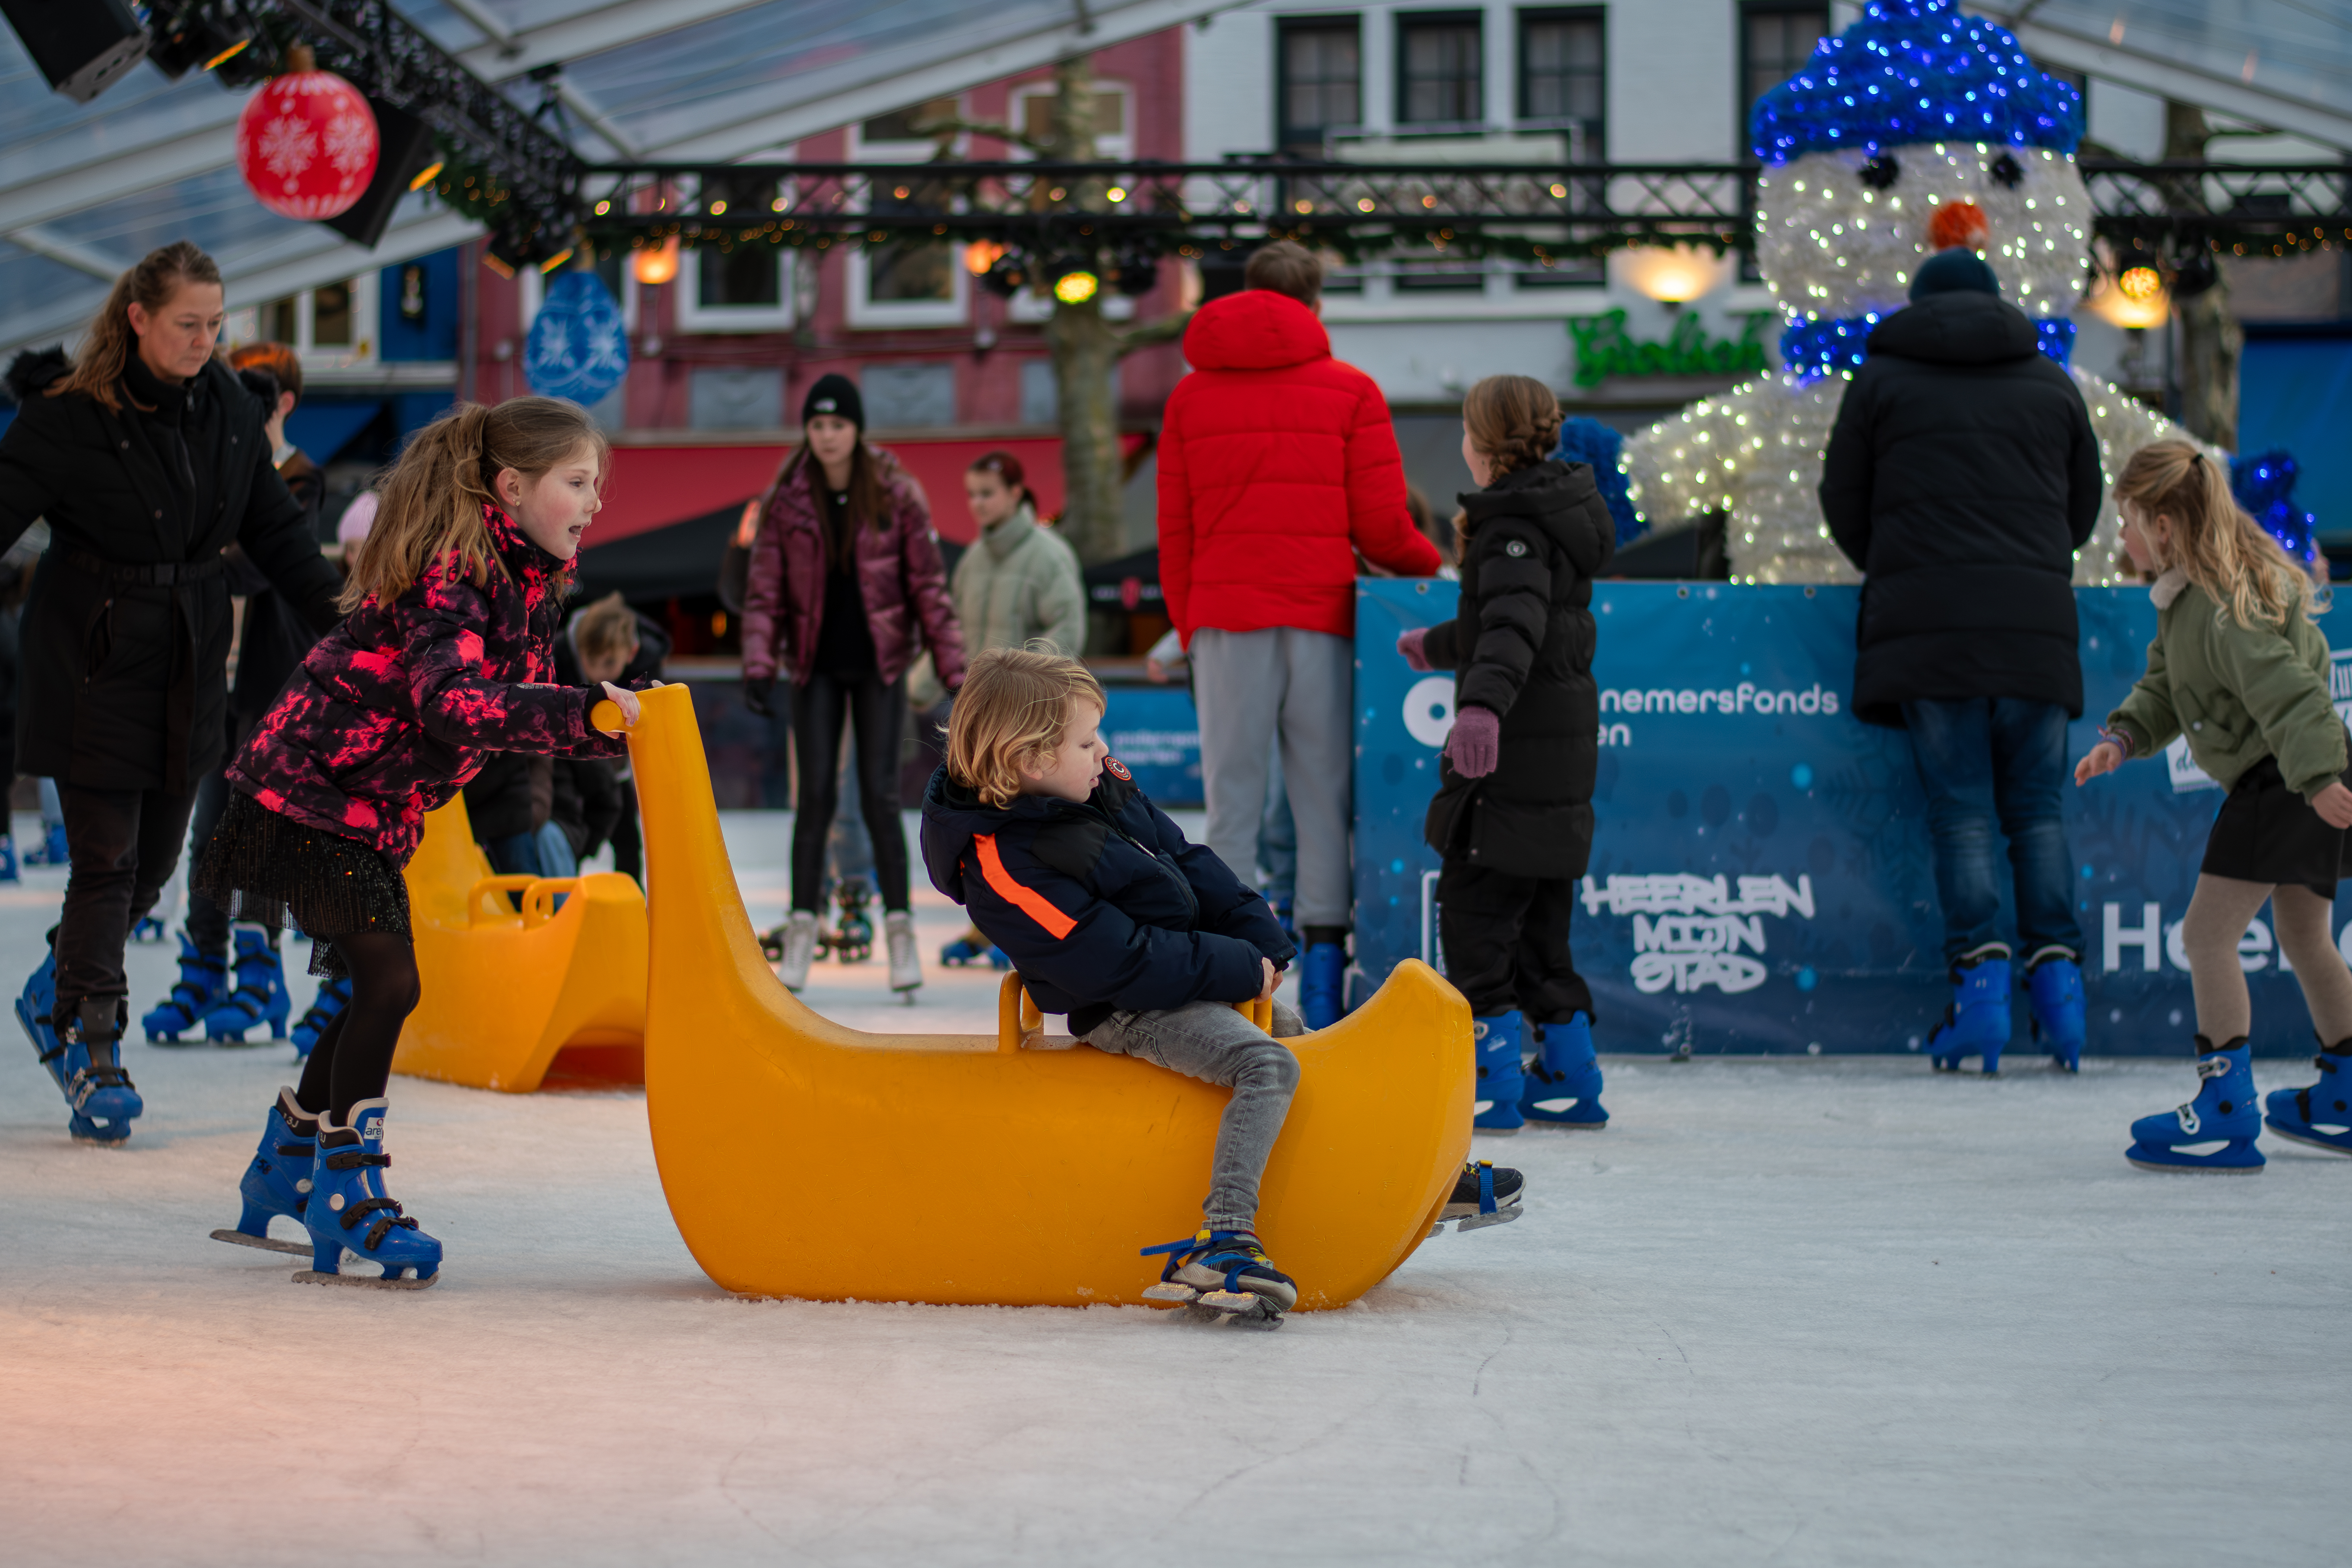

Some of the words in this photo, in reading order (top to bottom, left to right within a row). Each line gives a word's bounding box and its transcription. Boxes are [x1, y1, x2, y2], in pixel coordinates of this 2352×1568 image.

[1599, 681, 1839, 715] nemersfonds
[1580, 872, 1815, 918] HEERLEN
[1632, 913, 1766, 953] MIJN
[1630, 951, 1767, 993] STAD
